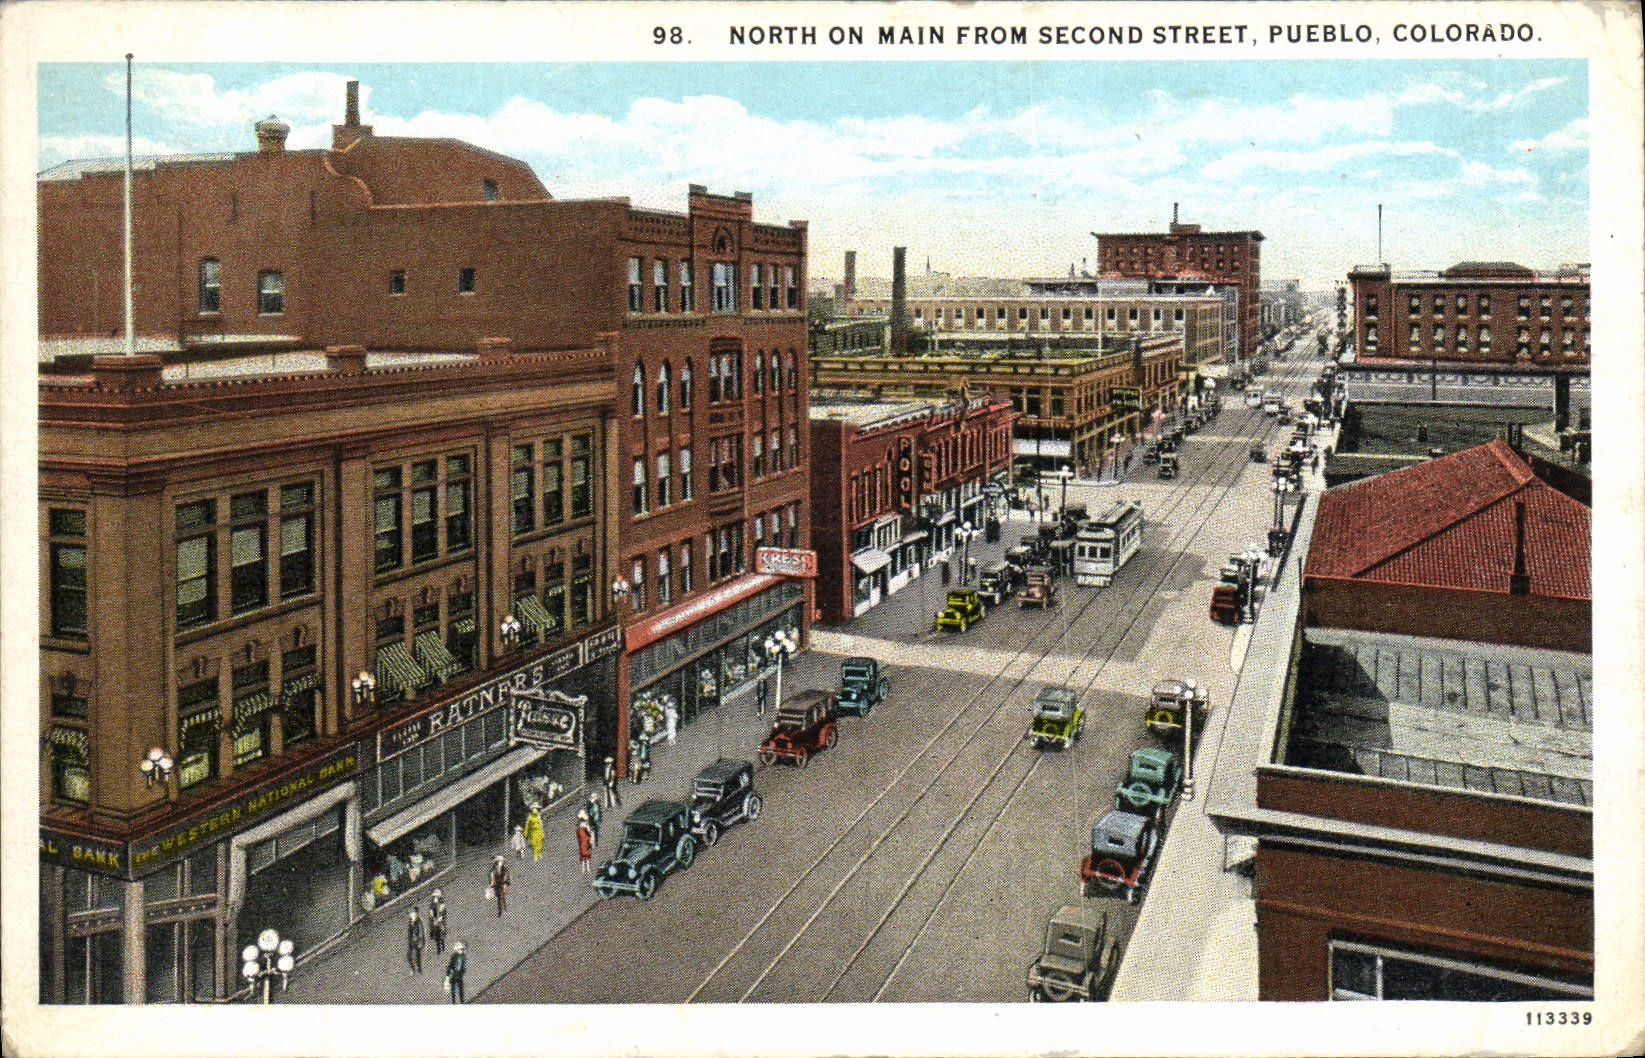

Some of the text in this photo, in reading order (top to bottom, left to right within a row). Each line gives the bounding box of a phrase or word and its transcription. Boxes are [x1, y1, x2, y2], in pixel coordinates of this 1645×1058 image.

[900, 438, 911, 509] POOL
[160, 807, 242, 849] WESTERN
[247, 775, 316, 814] NATIONAL
[319, 755, 357, 780] BANK
[72, 845, 120, 868] BANK
